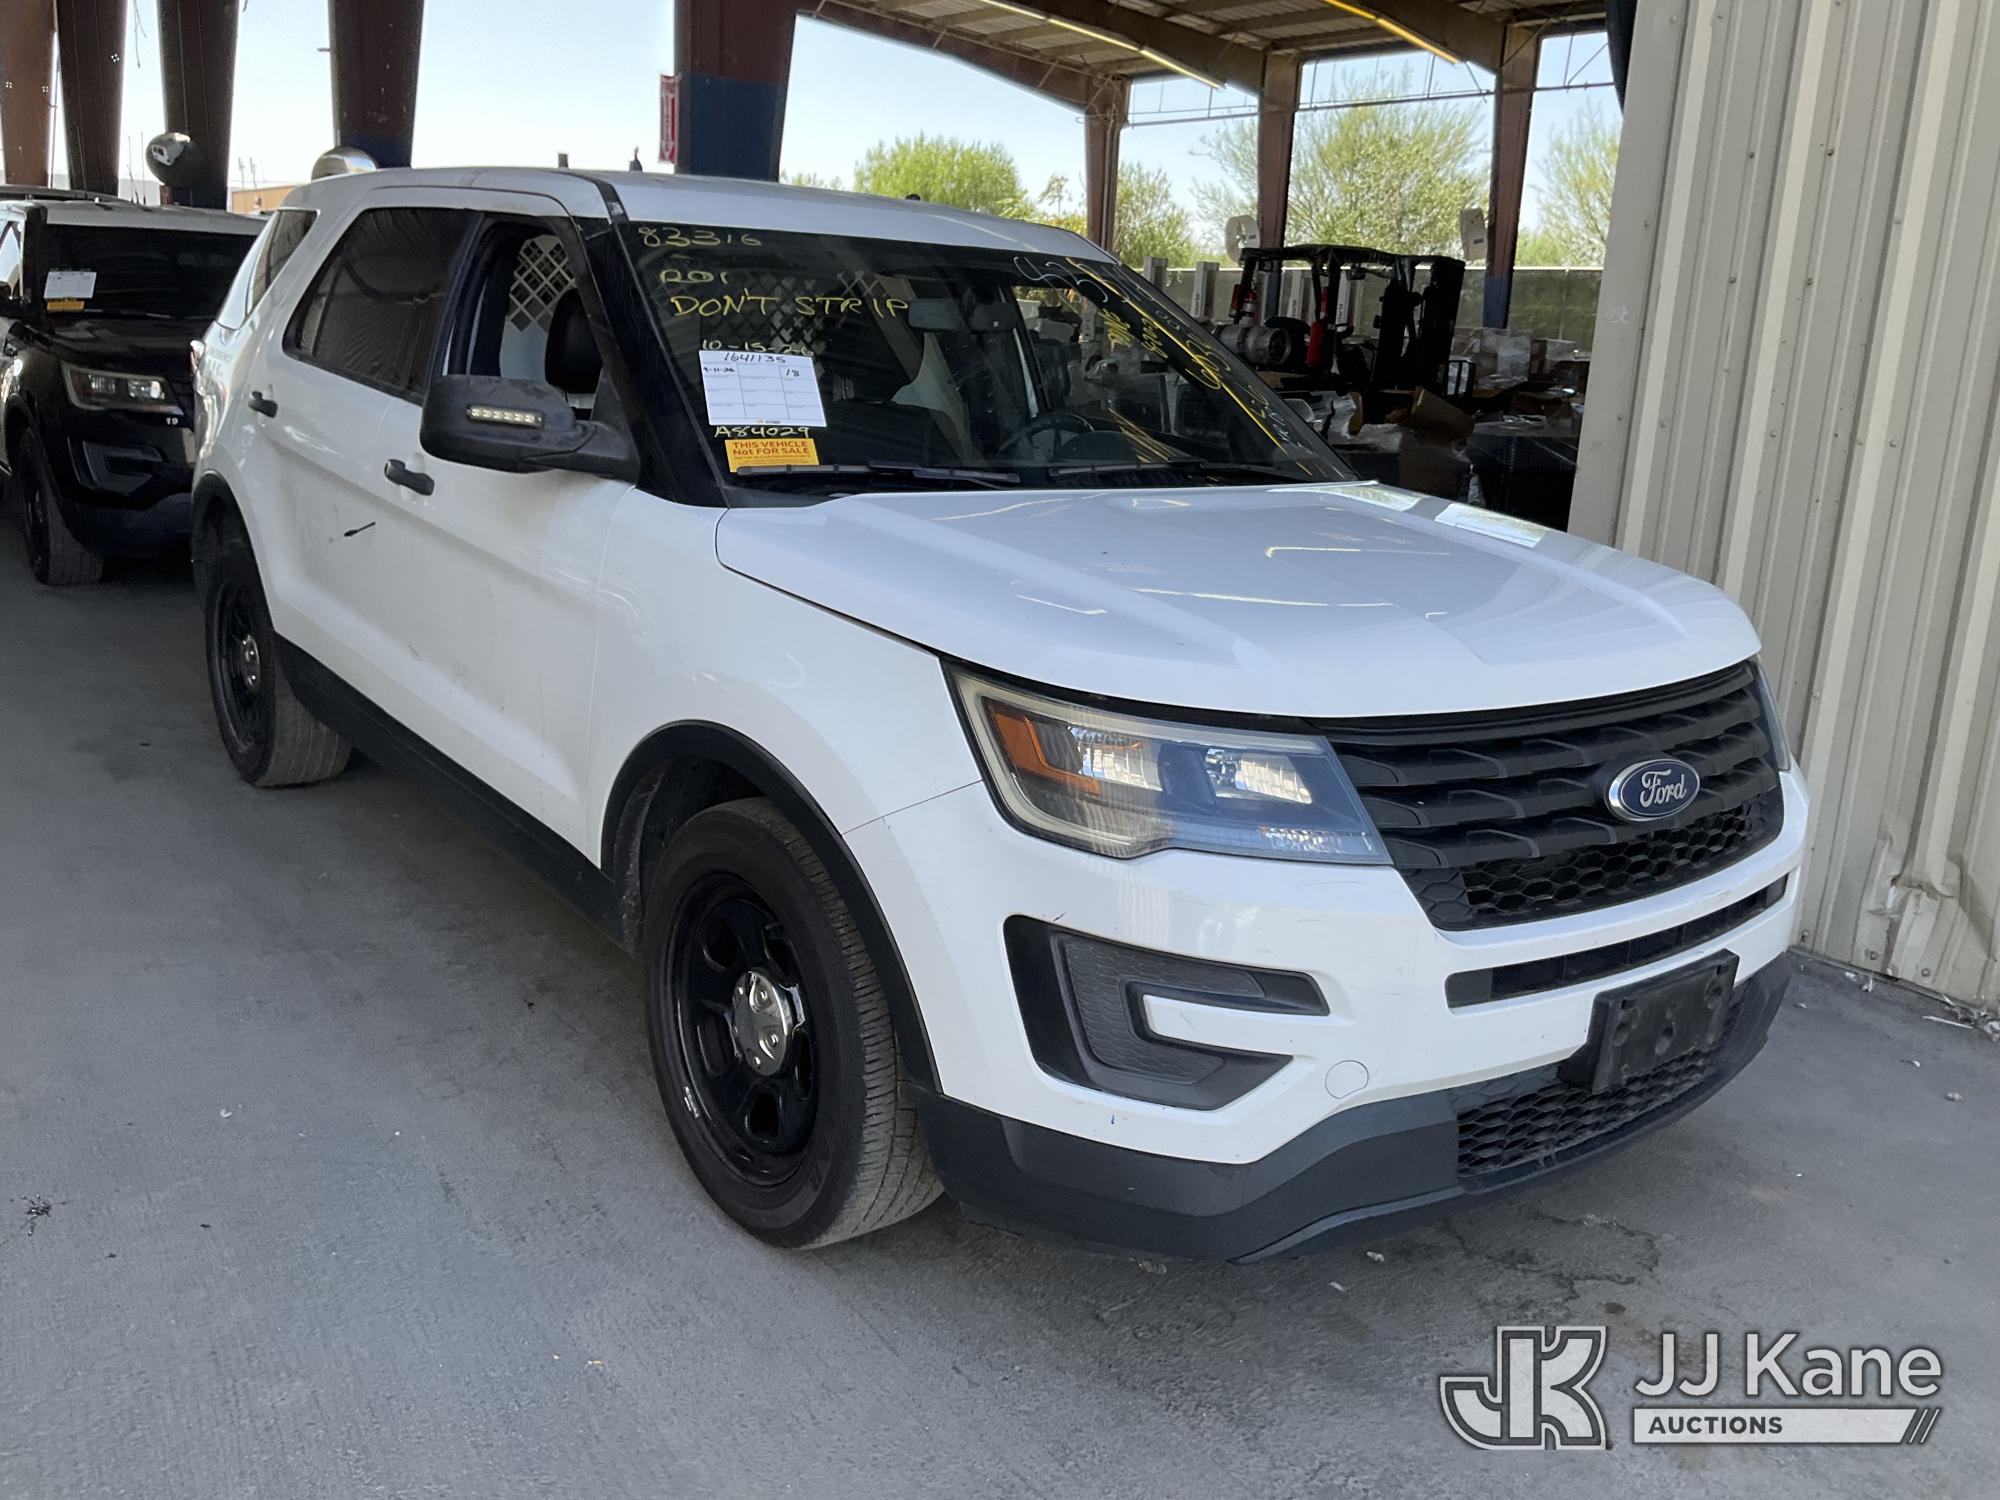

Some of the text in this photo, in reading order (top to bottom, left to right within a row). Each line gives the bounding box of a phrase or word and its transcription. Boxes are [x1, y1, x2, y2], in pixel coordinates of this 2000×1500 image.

[638, 226, 762, 248] 83316
[670, 287, 909, 319] DON'T STRIP
[732, 440, 809, 449] THIS VEHICLE
[733, 448, 754, 456] Not
[756, 447, 779, 455] FOR
[1640, 768, 1687, 808] Ford
